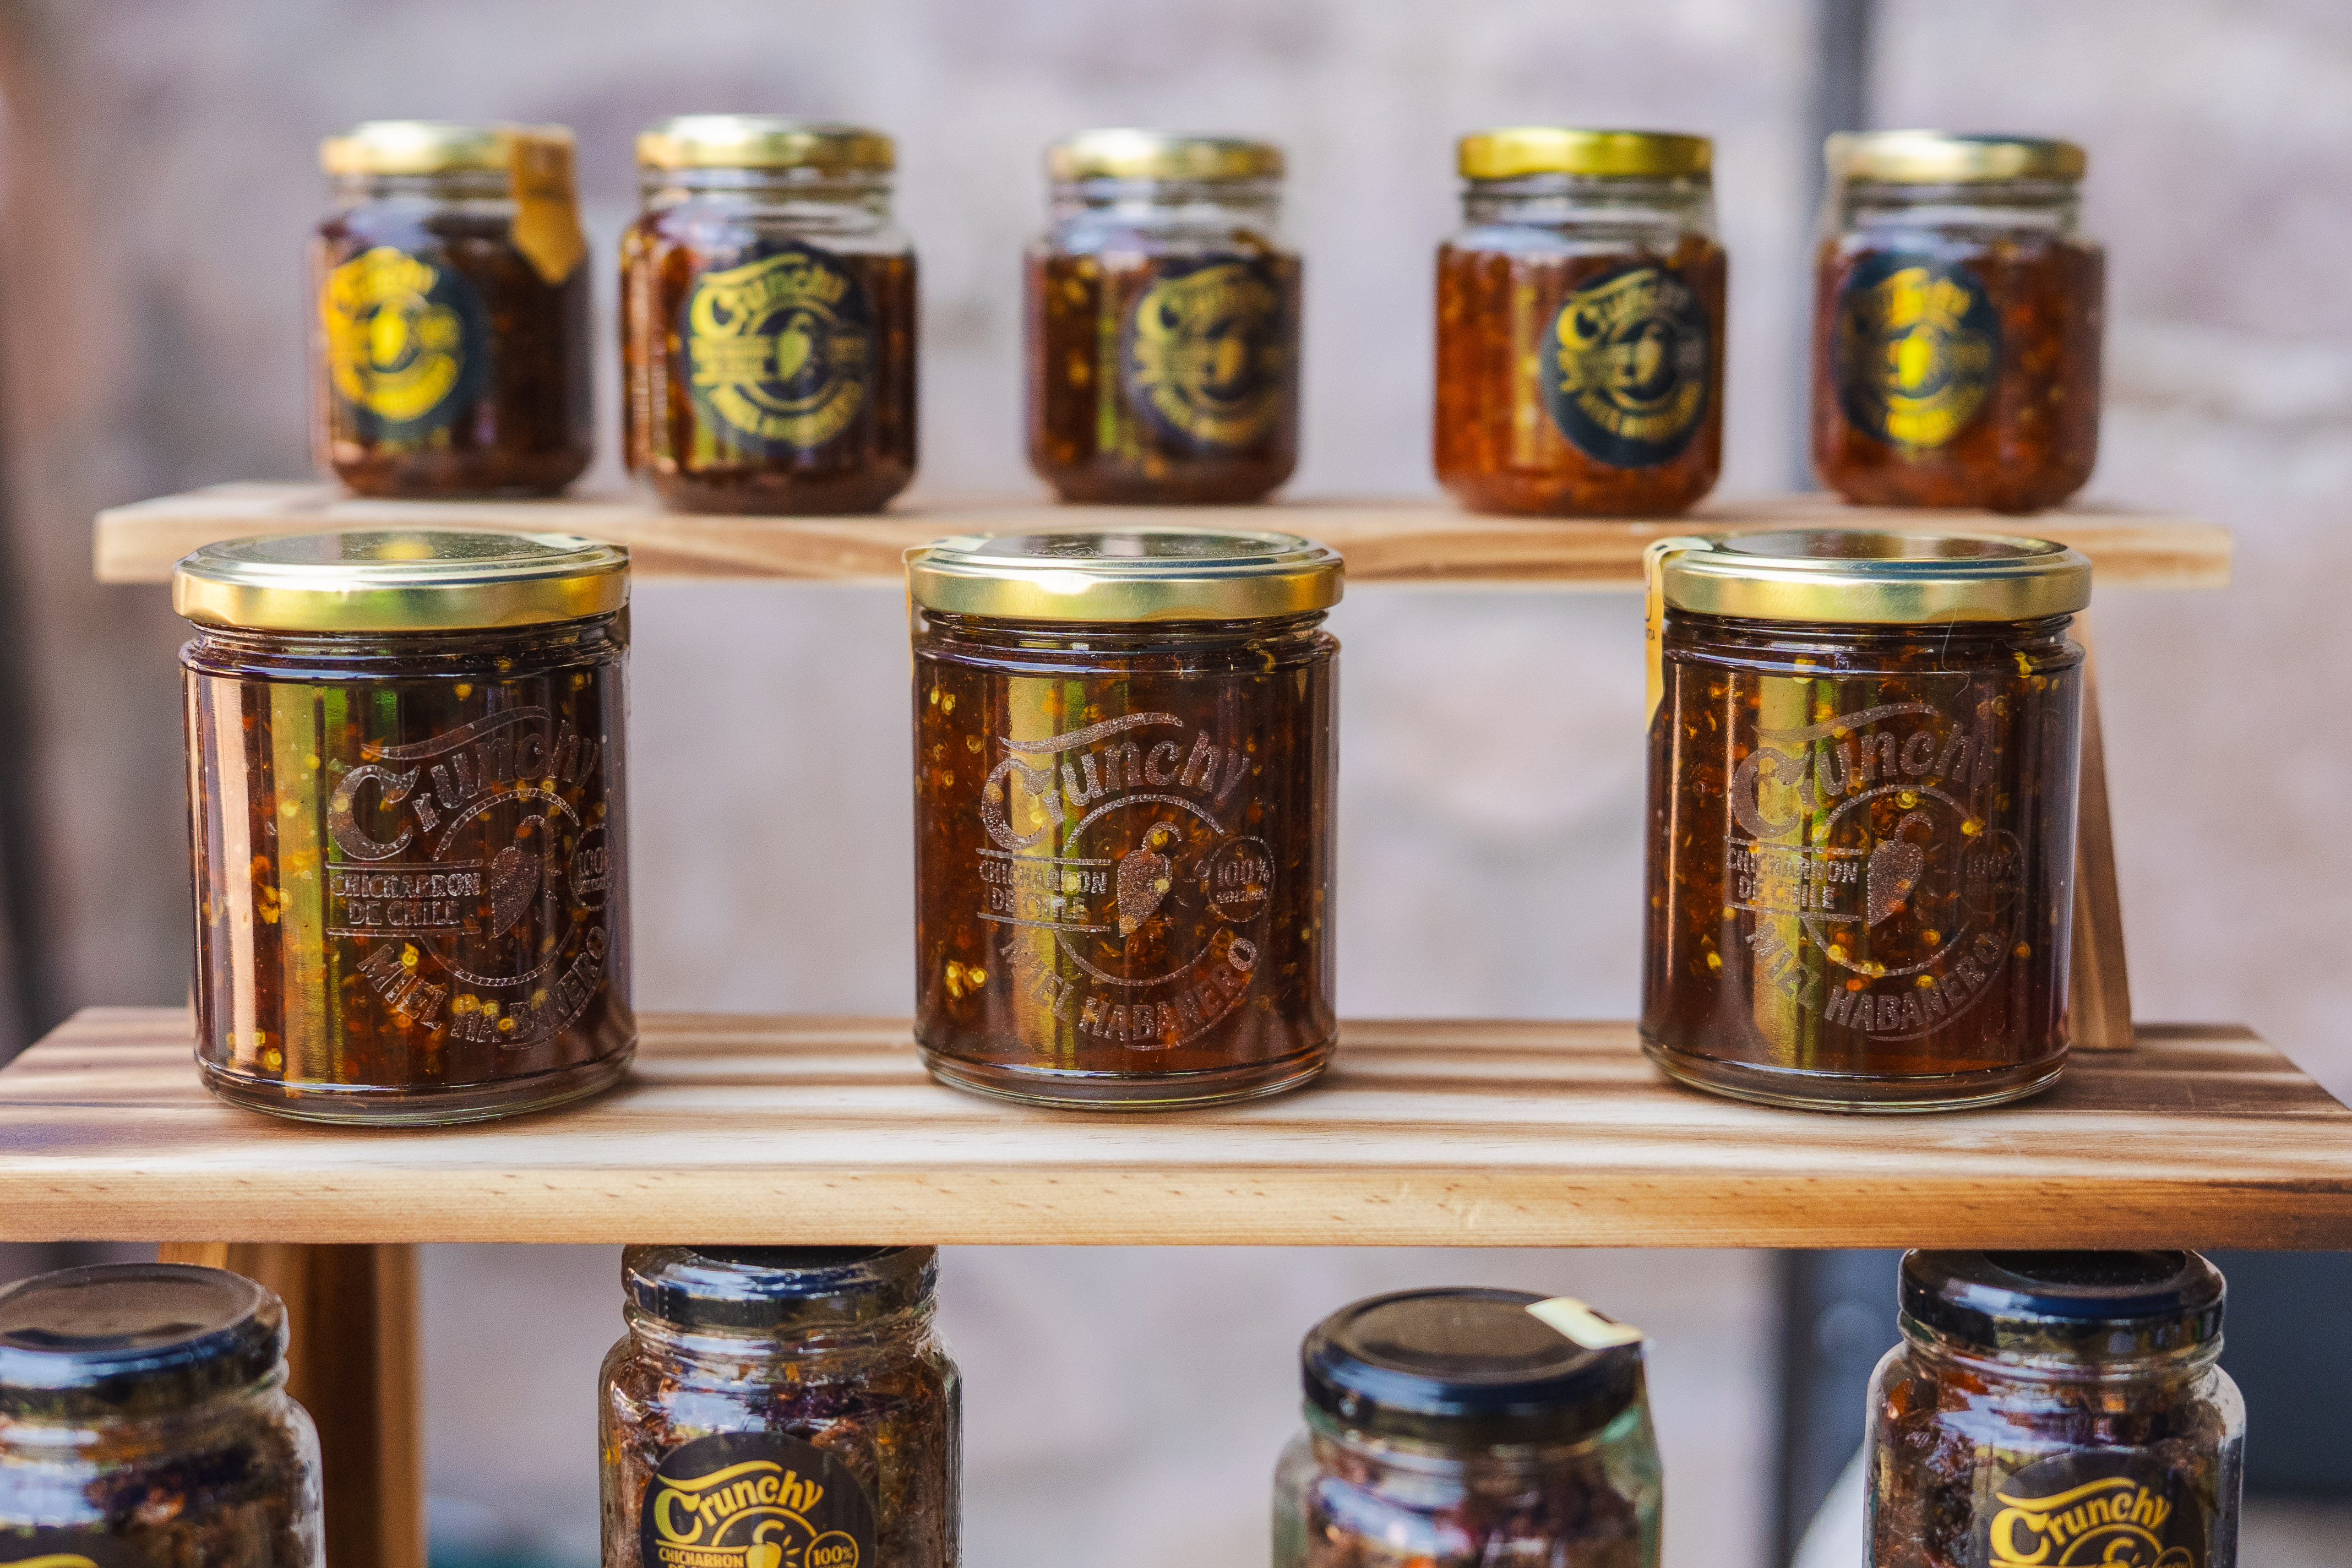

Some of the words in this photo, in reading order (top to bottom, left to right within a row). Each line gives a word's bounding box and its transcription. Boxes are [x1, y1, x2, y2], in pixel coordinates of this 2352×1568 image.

[329, 716, 599, 861] Crunchy
[982, 726, 1250, 850] Crunchy
[979, 860, 1107, 894] CHICHARRON
[1217, 857, 1270, 887] 100%
[1726, 847, 1859, 883] CHICHARRON
[331, 873, 481, 898] CHICHARRON
[992, 888, 1016, 912] DE
[1739, 875, 1765, 900] DE
[1771, 880, 1836, 908] CHILE
[349, 900, 382, 925] DE
[387, 900, 460, 925] CHILE
[356, 943, 447, 1030] MIEL
[1079, 938, 1257, 1041] HABANERO
[1824, 933, 1999, 1031] HABANERO
[654, 1466, 824, 1544] Crunchy
[1990, 1482, 2173, 1564] Crunchy
[658, 1547, 744, 1568] CHICHARRON
[813, 1544, 853, 1566] 100%
